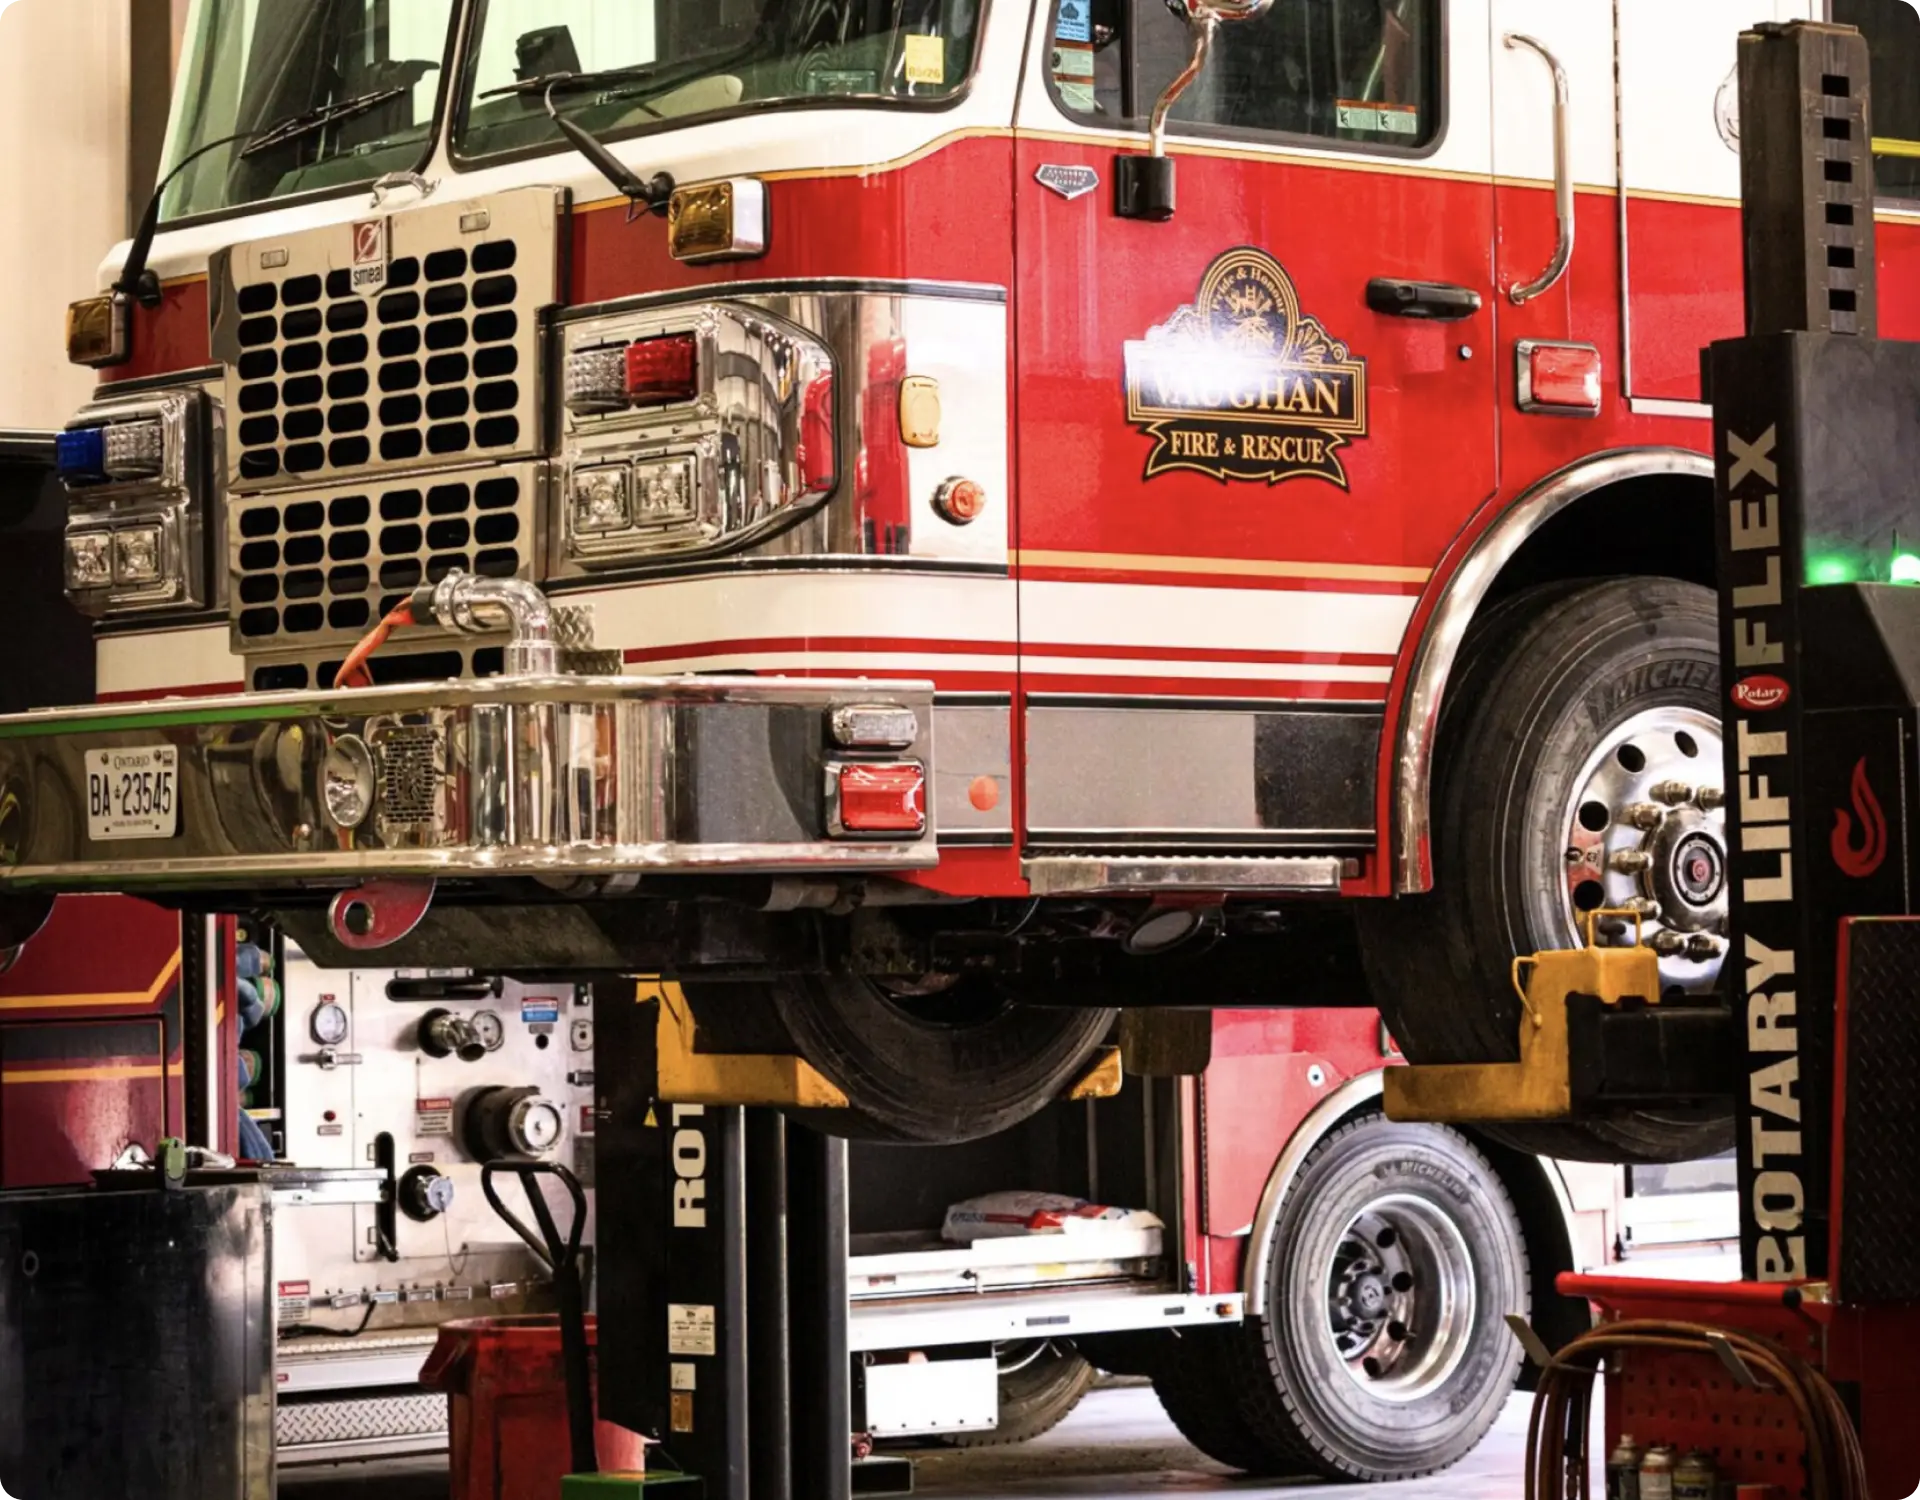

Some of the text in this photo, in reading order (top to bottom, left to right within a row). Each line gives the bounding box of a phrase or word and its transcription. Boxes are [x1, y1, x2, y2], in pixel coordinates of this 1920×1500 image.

[353, 264, 383, 286] smeal
[1236, 267, 1248, 280] &
[1169, 430, 1326, 464] FIRE & RESCUE
[1726, 421, 1785, 668] FLEX
[1613, 660, 1722, 709] MICHEL
[1736, 683, 1785, 702] Rotary
[91, 772, 172, 816] BA 23545
[1737, 719, 1807, 1282] ROTARY LIFT
[672, 1103, 706, 1228] ROT
